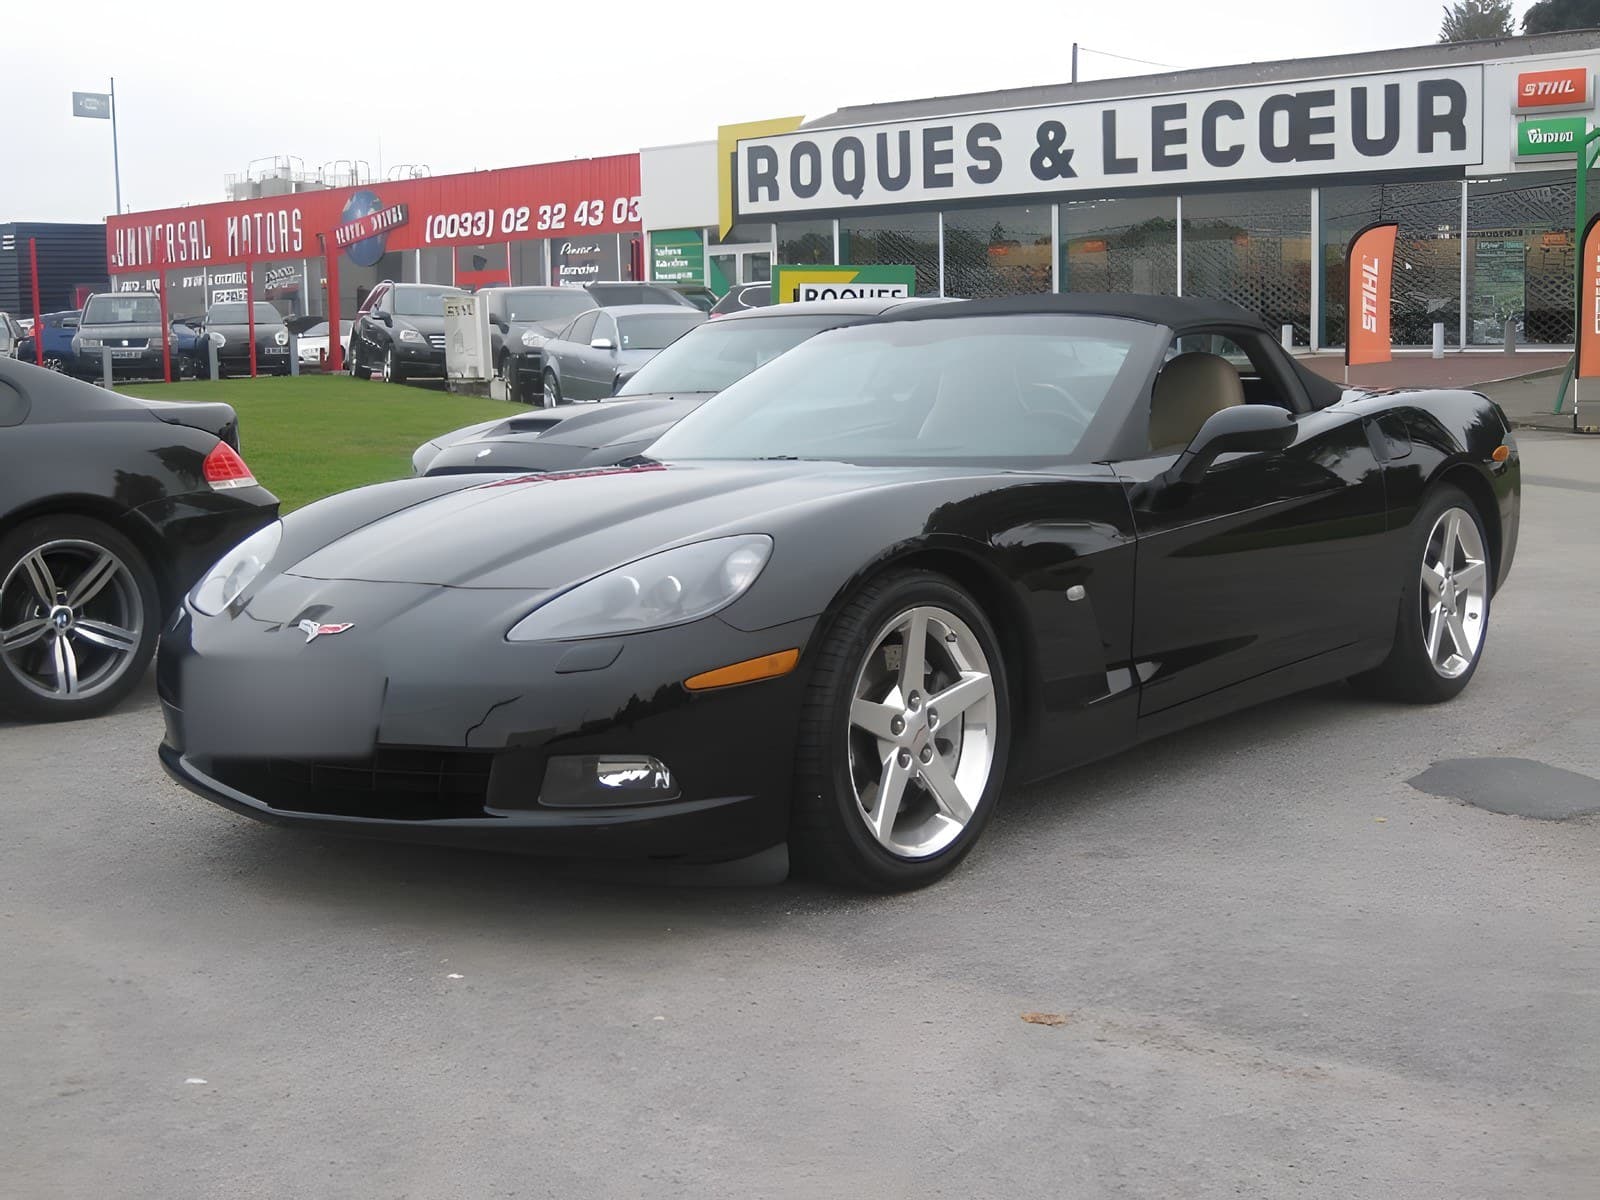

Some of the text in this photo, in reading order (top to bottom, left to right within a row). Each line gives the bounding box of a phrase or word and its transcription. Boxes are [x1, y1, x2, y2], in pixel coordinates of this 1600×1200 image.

[1521, 79, 1575, 96] STIHL
[747, 78, 1468, 202] ROQUES & LECŒUR
[227, 208, 302, 257] MOTORS
[425, 196, 642, 243] (0033) 02 32 43 03
[1362, 258, 1379, 333] STIHL
